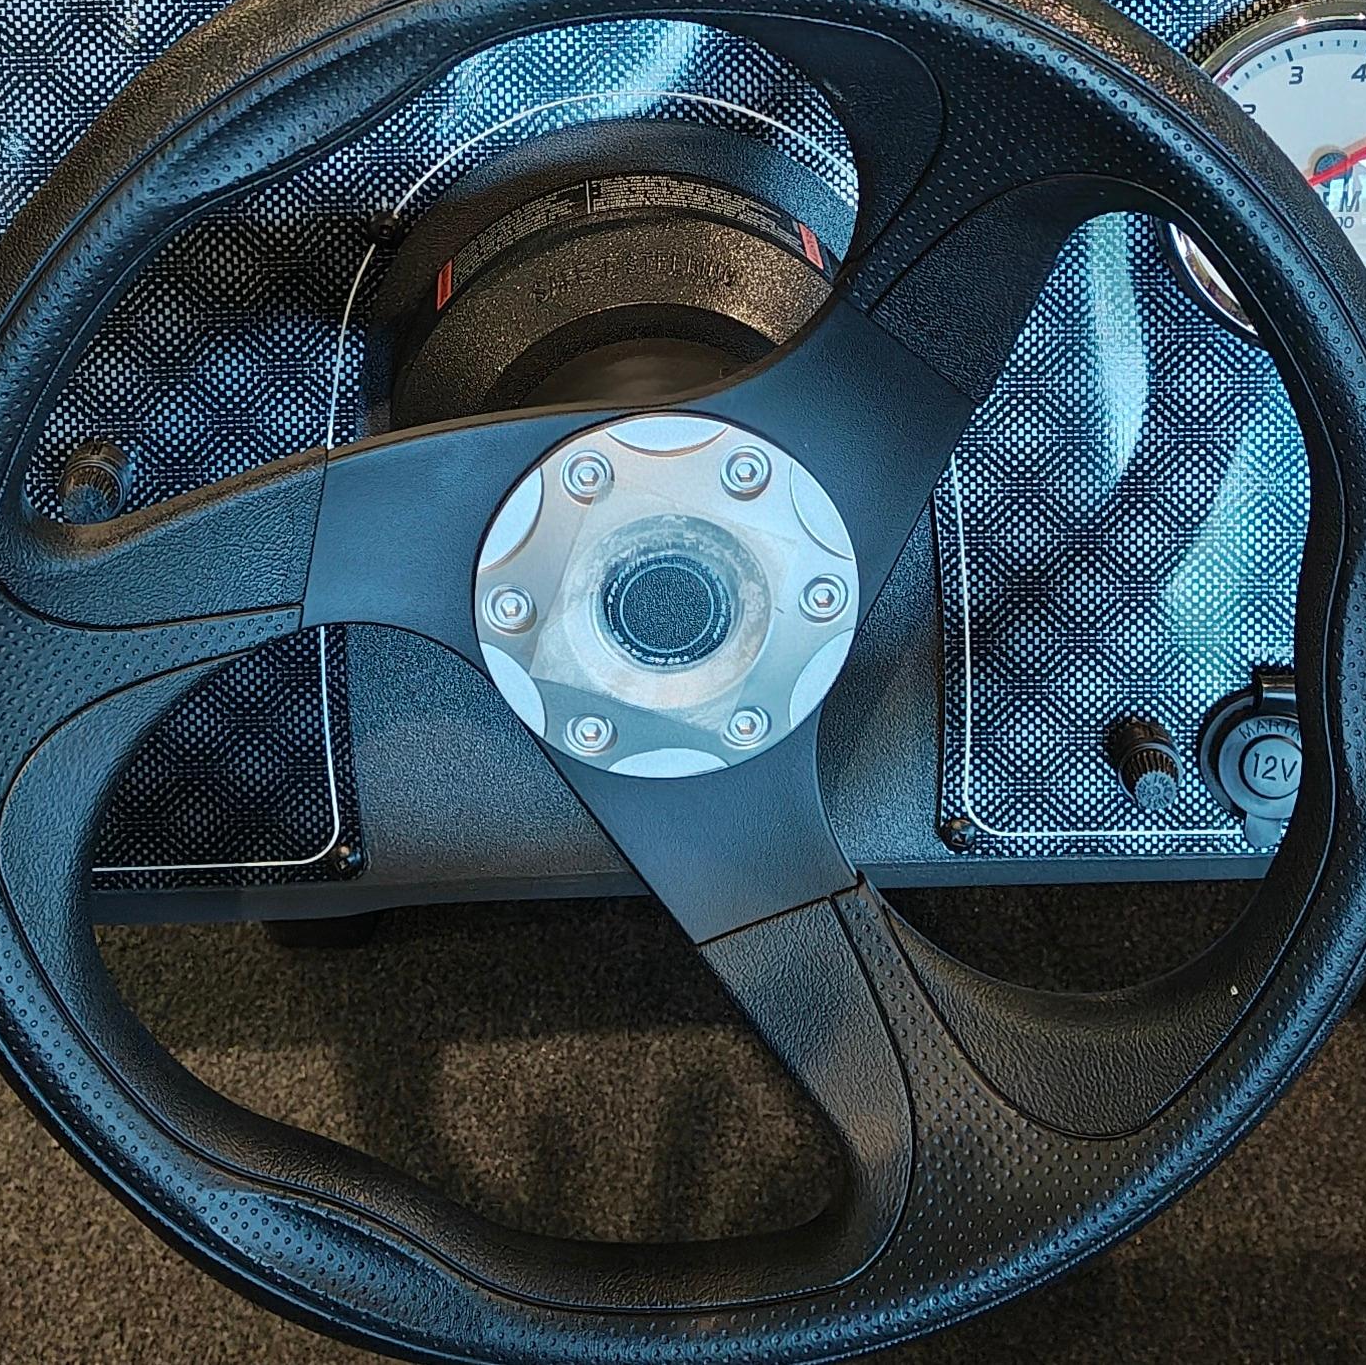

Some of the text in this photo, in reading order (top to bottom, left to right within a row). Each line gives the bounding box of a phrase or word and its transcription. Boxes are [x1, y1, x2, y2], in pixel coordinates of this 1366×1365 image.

[1289, 66, 1304, 85] 3
[1238, 718, 1300, 742] MARIN
[1254, 751, 1298, 782] 12V
